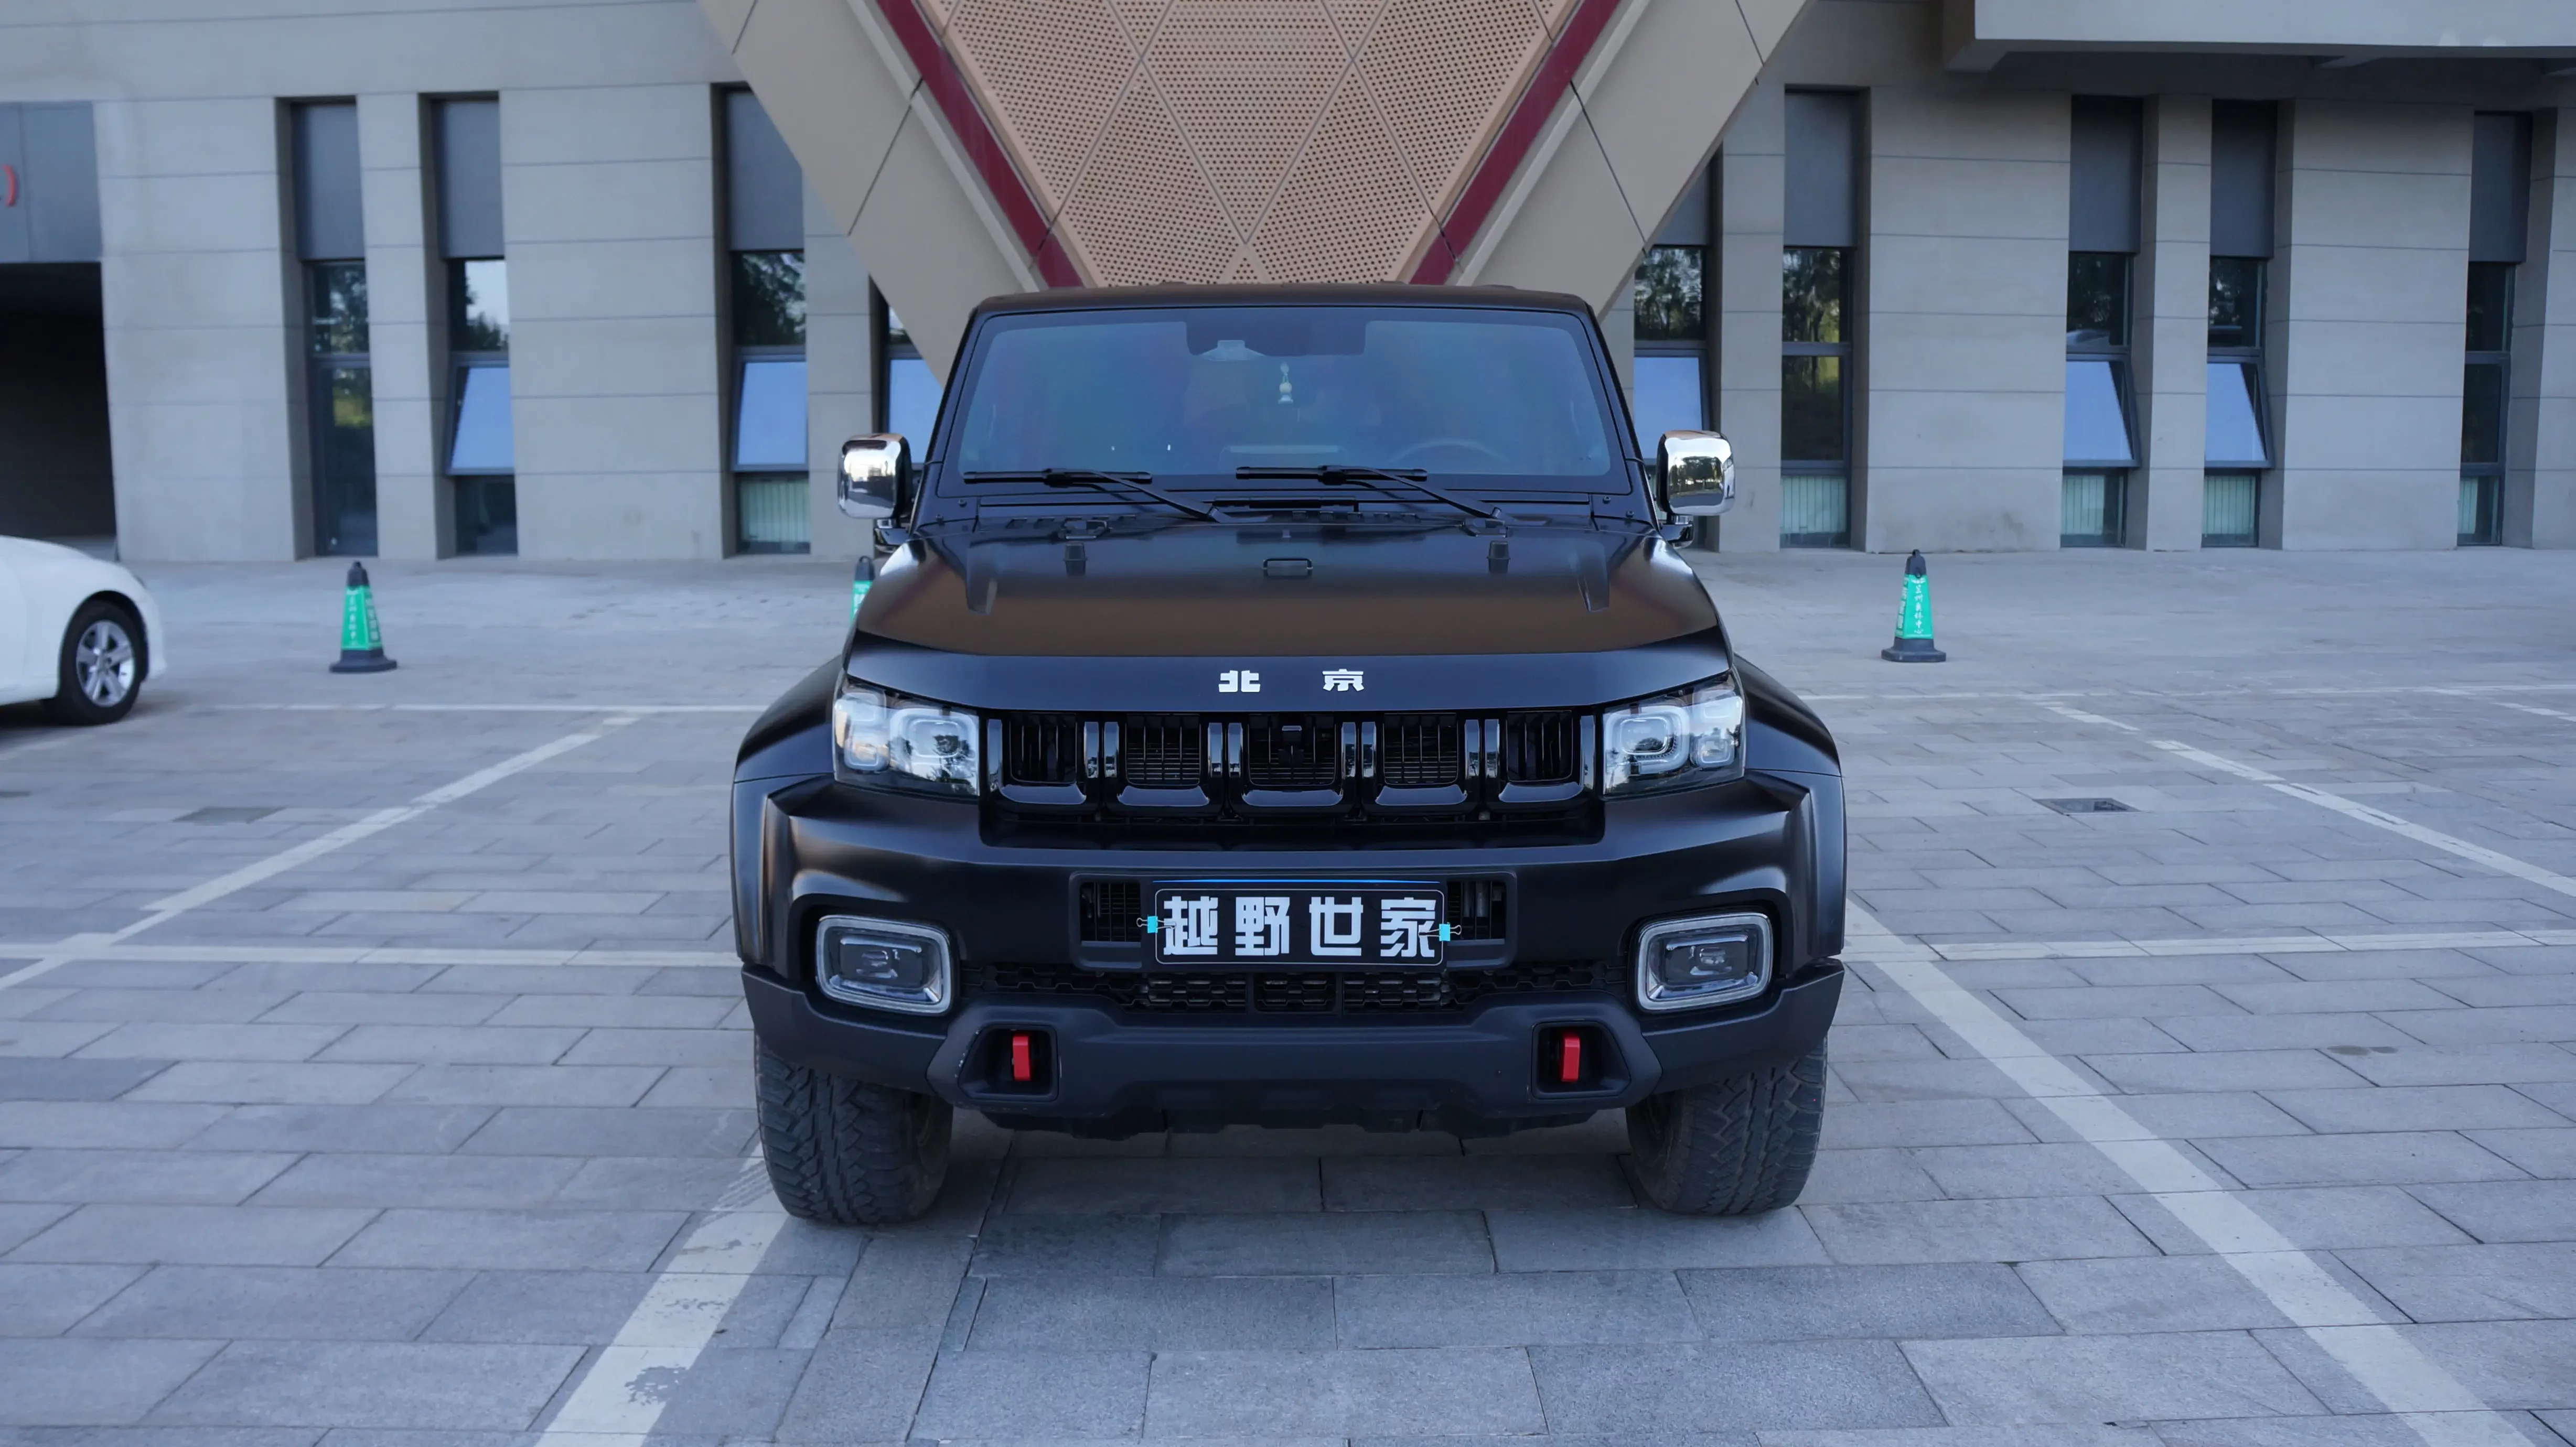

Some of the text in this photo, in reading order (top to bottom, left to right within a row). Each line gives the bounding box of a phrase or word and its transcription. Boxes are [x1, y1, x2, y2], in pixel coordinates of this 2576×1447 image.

[1218, 668, 1365, 693] 北京
[1163, 896, 1436, 958] 越野世家
